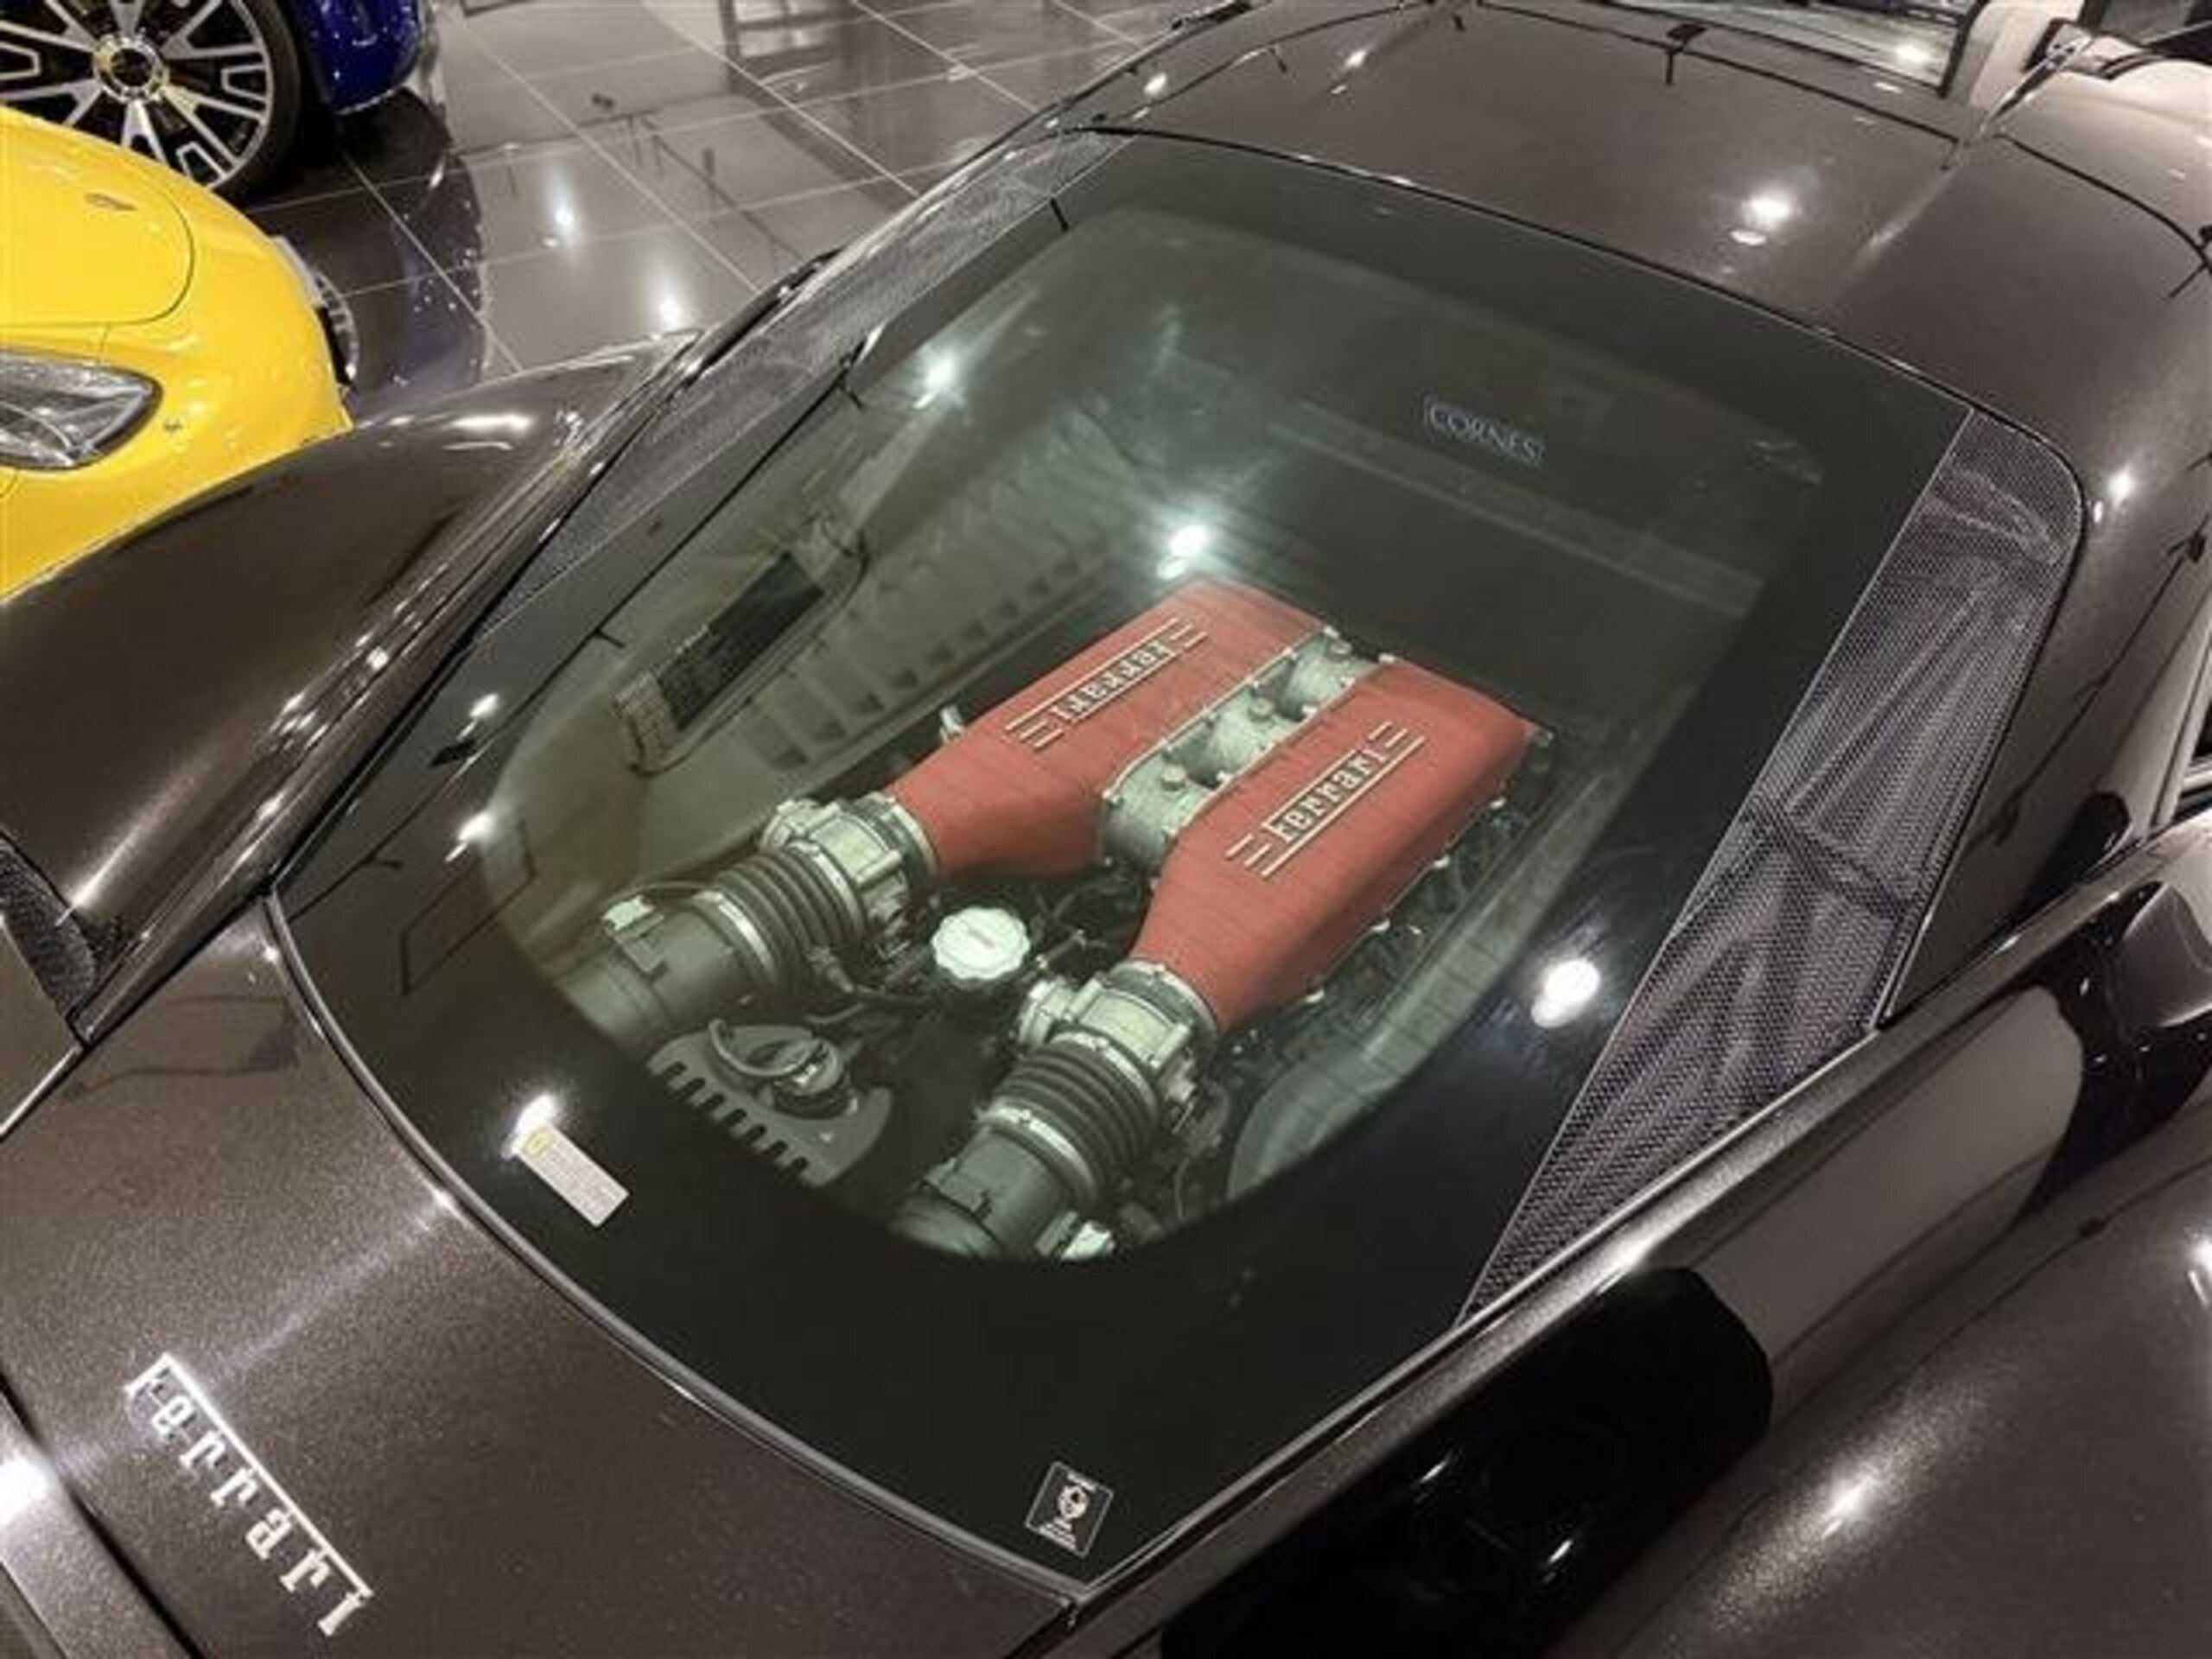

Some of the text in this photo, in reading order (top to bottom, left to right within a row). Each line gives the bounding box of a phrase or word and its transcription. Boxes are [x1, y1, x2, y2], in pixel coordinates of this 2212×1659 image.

[1427, 402, 1544, 468] CORNES
[1260, 748, 1386, 843] Ferrari
[124, 1352, 374, 1636] Ferrari
